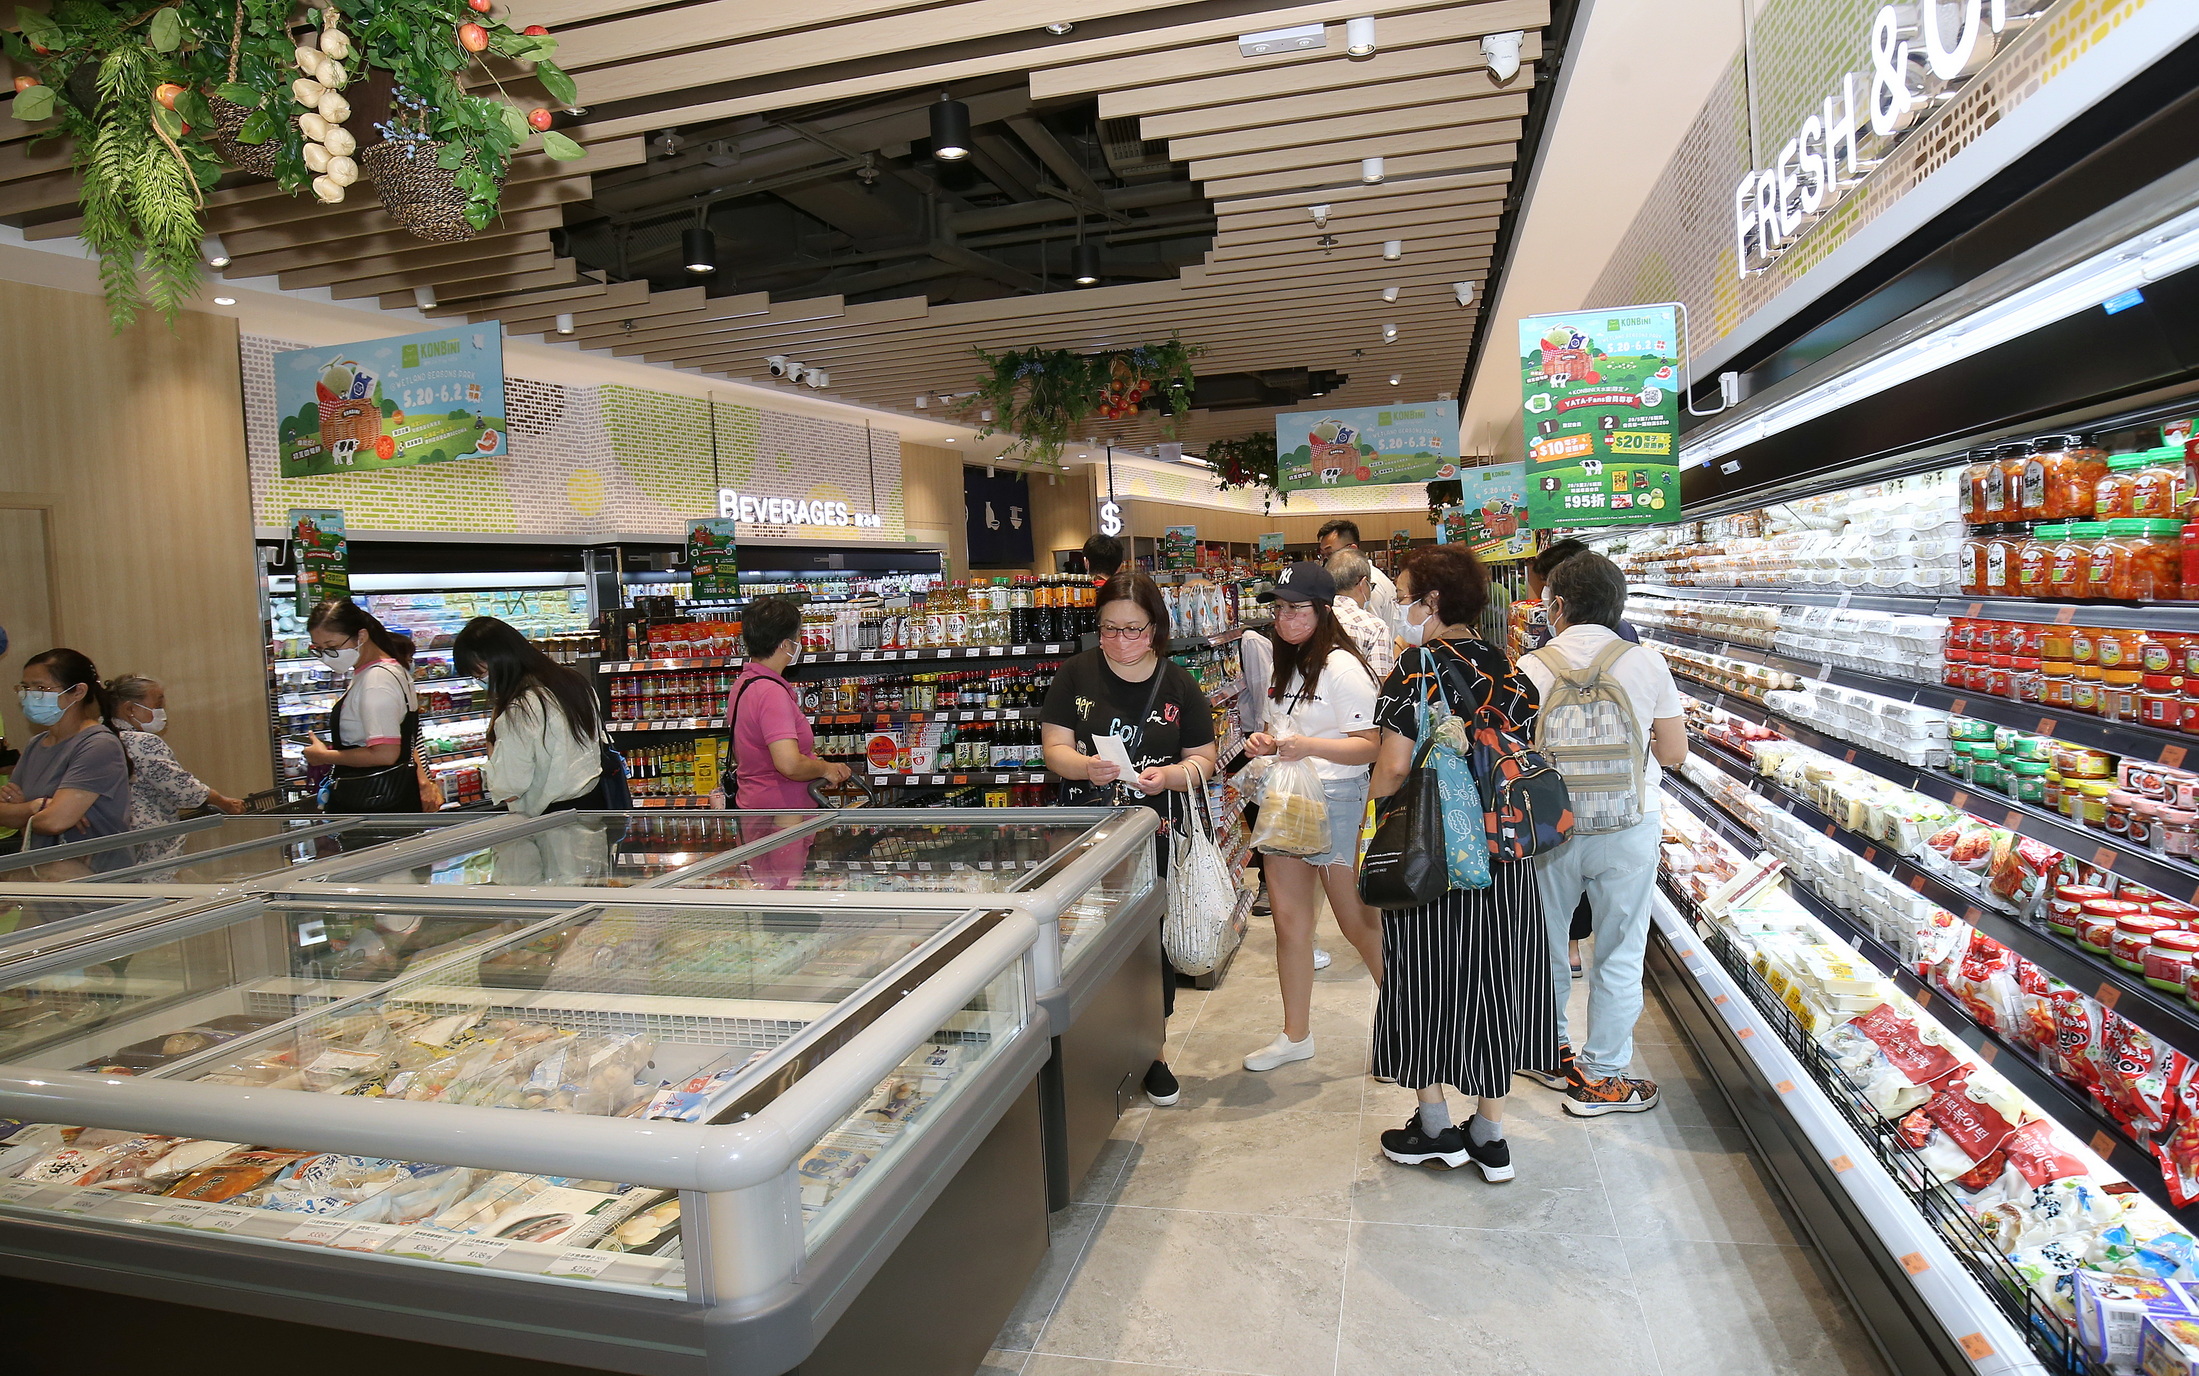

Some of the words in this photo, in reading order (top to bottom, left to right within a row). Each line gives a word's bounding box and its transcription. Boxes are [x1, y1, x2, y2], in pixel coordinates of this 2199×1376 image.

[1736, 72, 1856, 280] FRESH
[1871, 5, 1911, 136] &
[421, 340, 460, 358] KONBINI
[403, 383, 462, 408] 5.20-6.2
[1543, 421, 1551, 433] 1
[1604, 416, 1613, 429] 2
[1379, 436, 1426, 450] 5.20-6.2
[1540, 440, 1565, 456] $10
[1616, 435, 1643, 448] $20
[1545, 479, 1555, 490] 3
[719, 488, 849, 527] BEVERAGES
[1572, 493, 1606, 508] 95折
